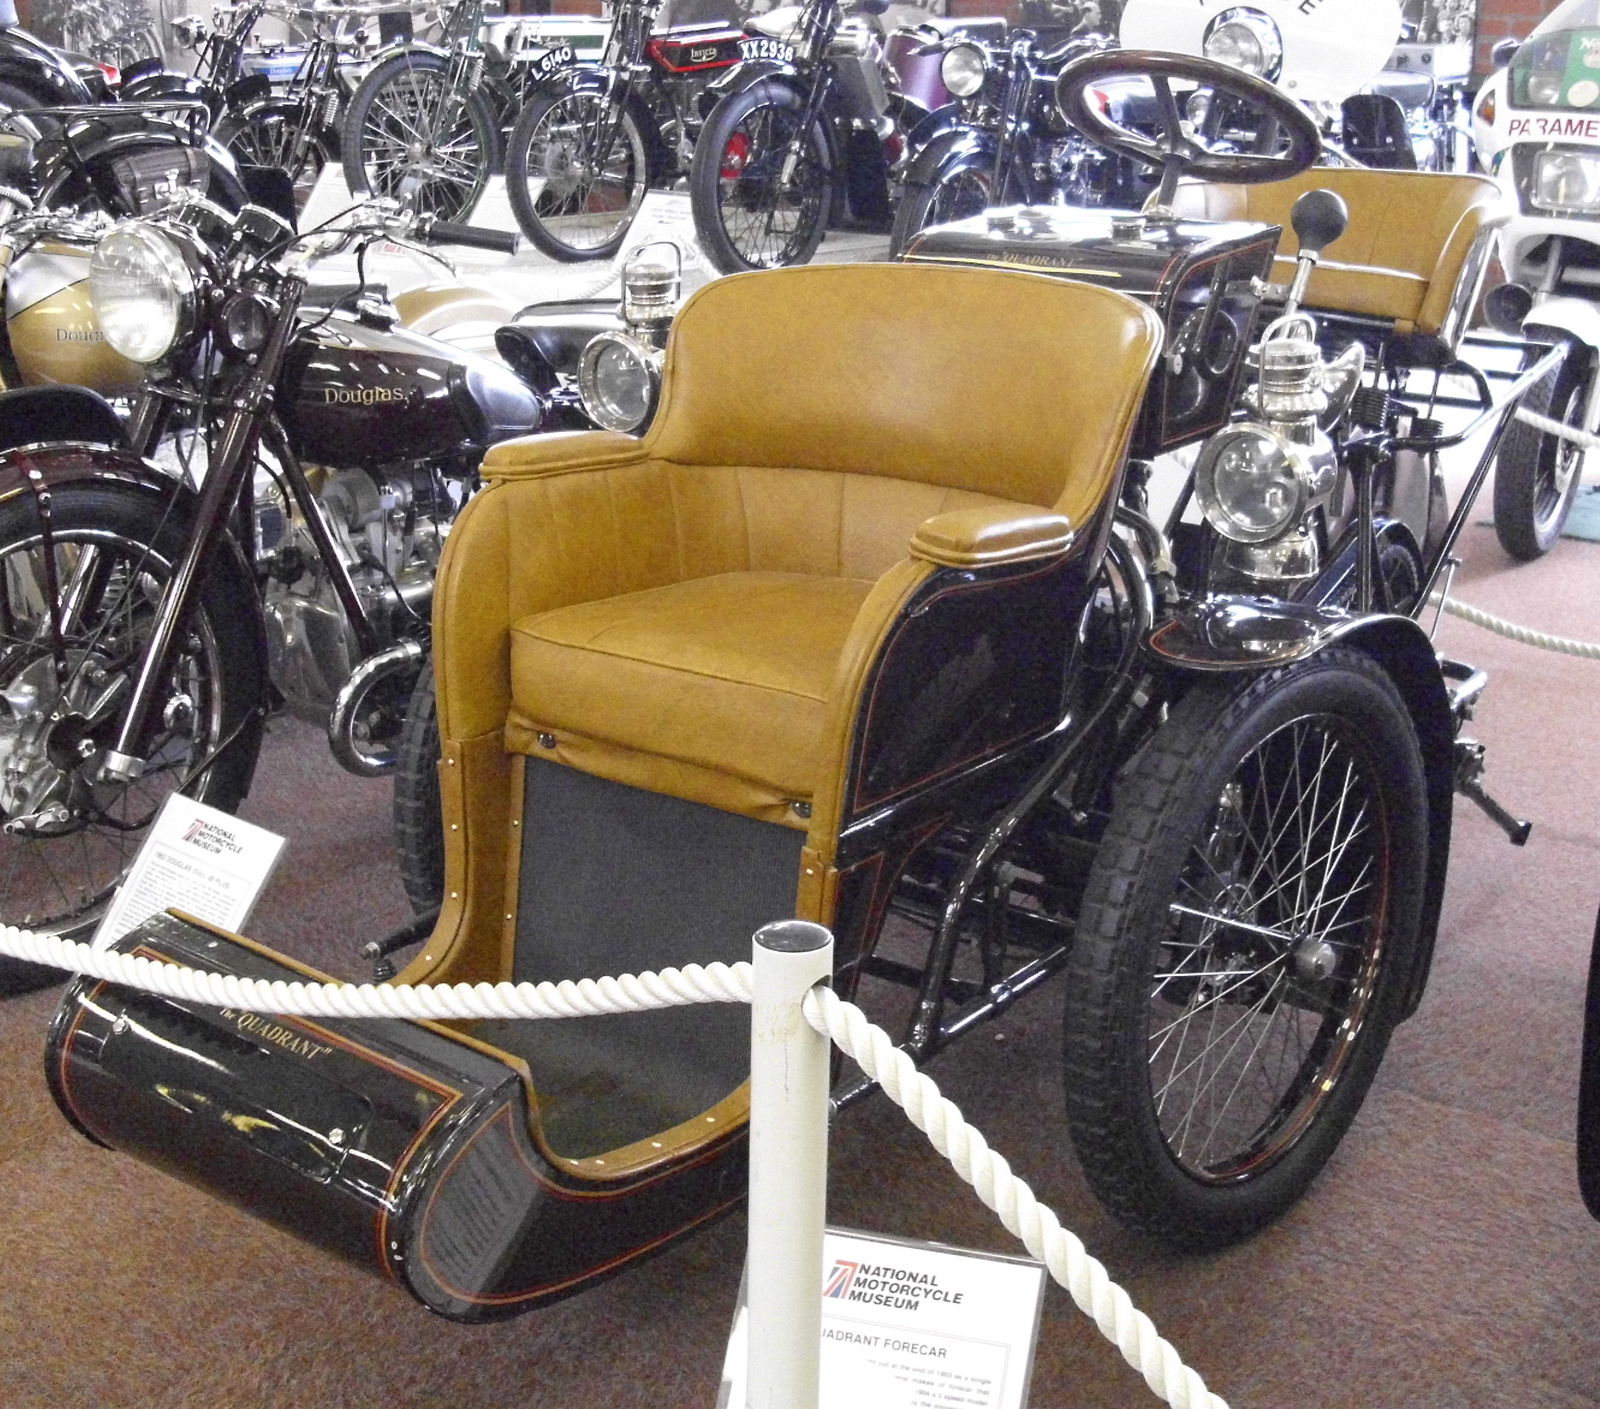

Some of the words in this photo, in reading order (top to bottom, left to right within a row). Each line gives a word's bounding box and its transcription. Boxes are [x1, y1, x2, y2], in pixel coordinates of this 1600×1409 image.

[542, 47, 572, 71] 6140
[324, 387, 404, 406] Douglas
[198, 830, 244, 854] MOTORCYCLE
[203, 823, 236, 841] NATIONAL
[192, 838, 222, 854] MUSEUM
[858, 1264, 938, 1287] NATIONAL
[848, 1290, 920, 1311] MUSEUM
[853, 1277, 964, 1304] MOTORCYCLE
[884, 1338, 948, 1358] FORECAR
